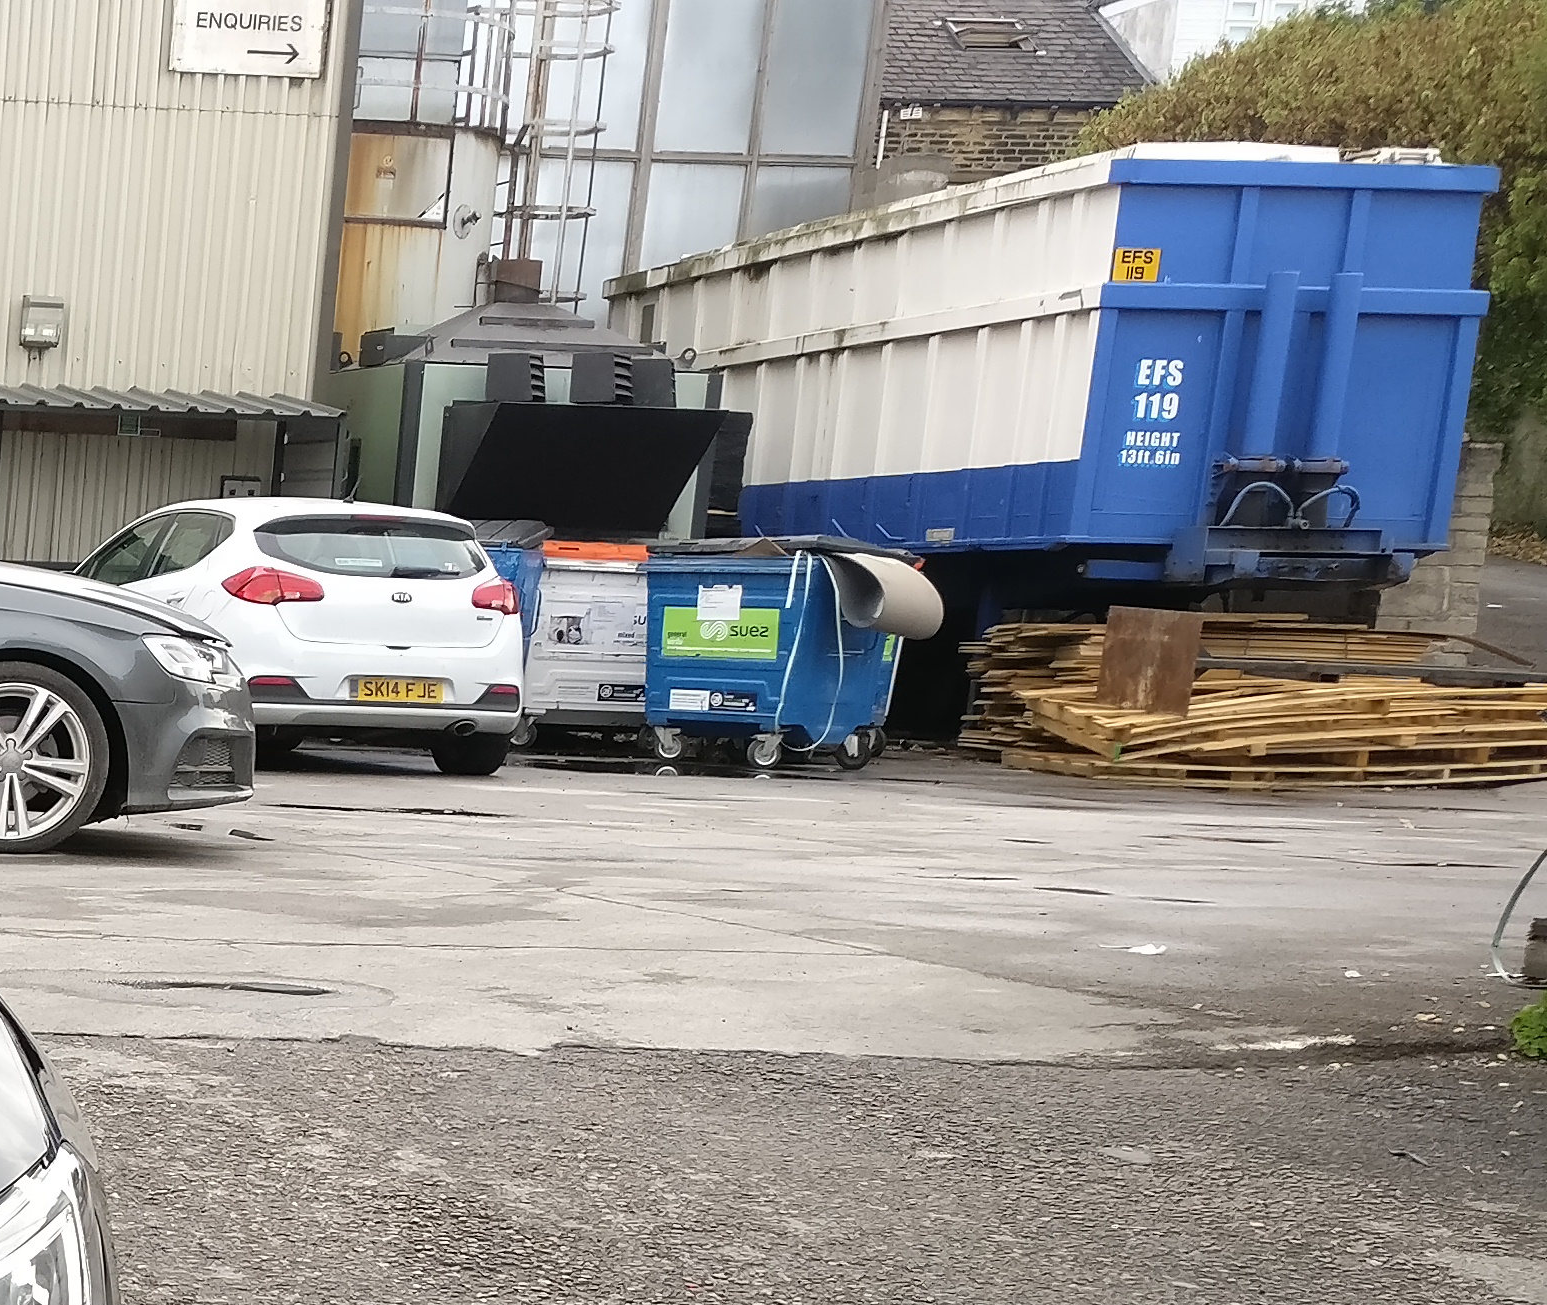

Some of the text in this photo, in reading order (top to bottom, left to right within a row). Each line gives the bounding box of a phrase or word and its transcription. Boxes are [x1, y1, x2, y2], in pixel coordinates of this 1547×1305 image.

[196, 11, 303, 32] ENQUIRIES
[1121, 250, 1154, 264] EFS
[1125, 266, 1145, 280] 119
[1136, 358, 1184, 388] EFS
[1133, 392, 1180, 420] 119
[1124, 430, 1181, 448] HEIGHT
[1119, 449, 1181, 466] 13ft.6in
[393, 592, 411, 602] KIA
[363, 681, 400, 698] SK14
